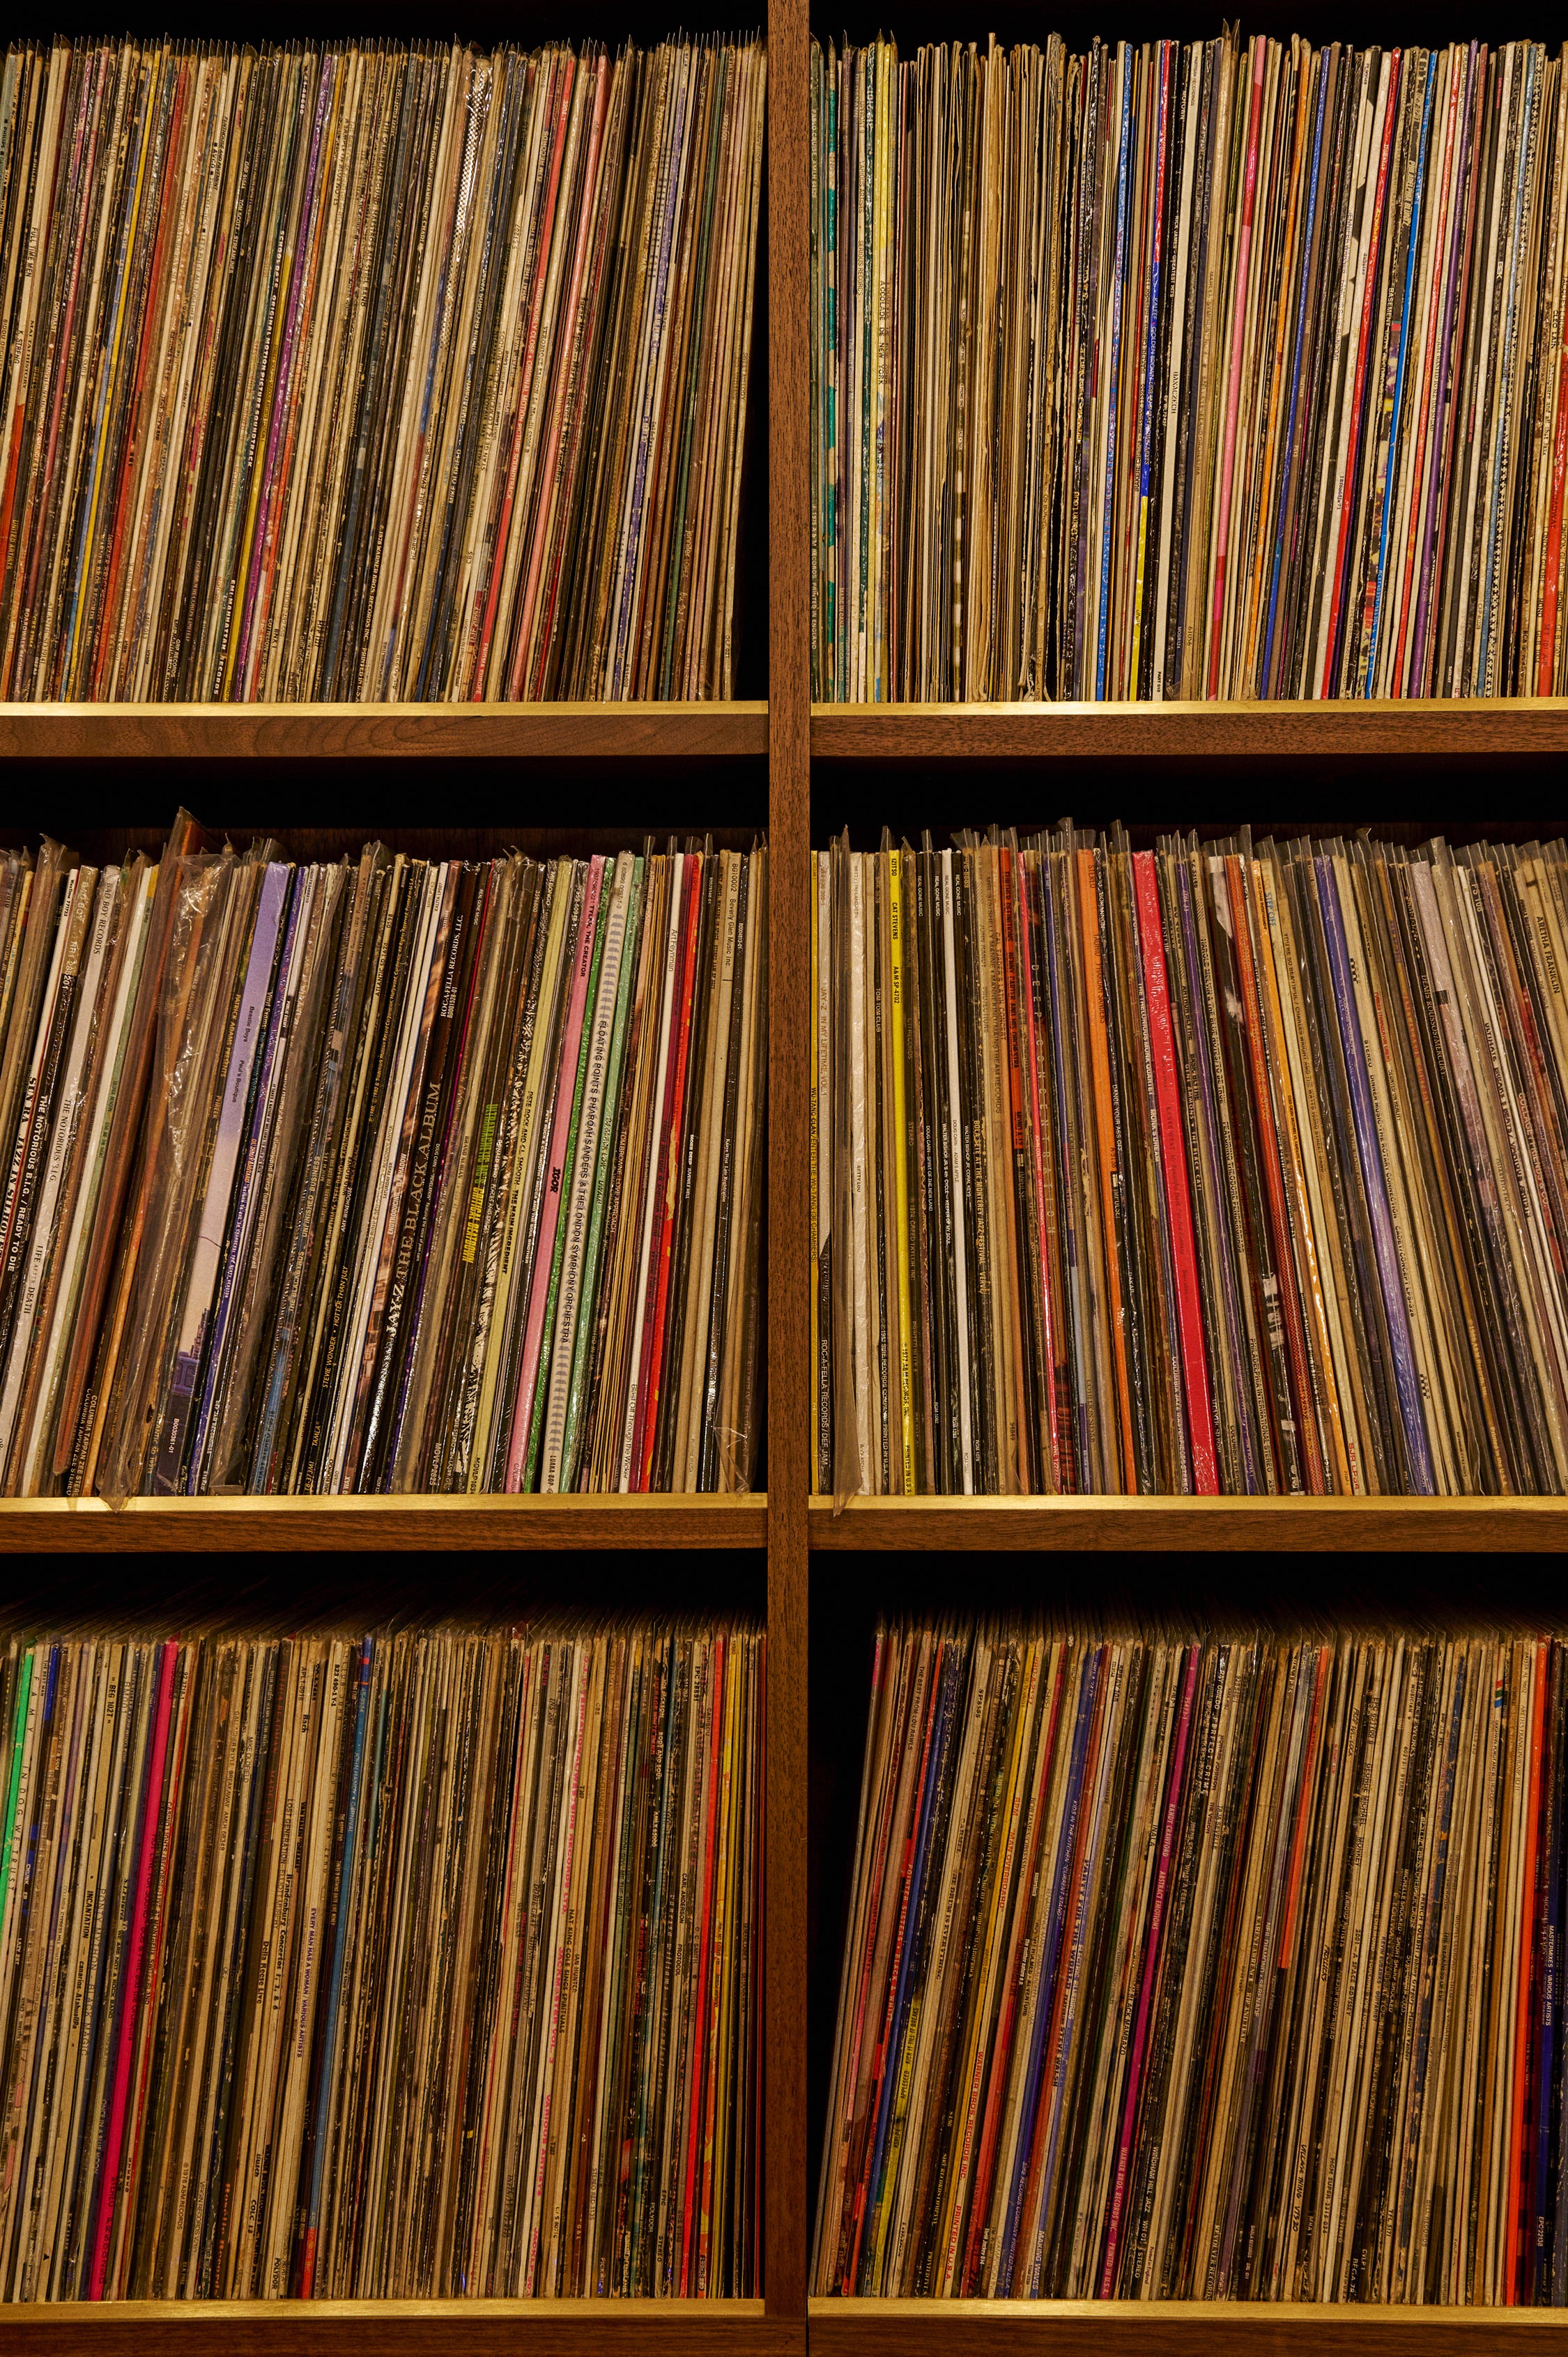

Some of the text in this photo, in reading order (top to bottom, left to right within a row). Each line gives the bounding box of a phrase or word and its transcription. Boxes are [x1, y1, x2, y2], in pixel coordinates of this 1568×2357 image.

[29, 227, 38, 243] FULL
[27, 245, 36, 261] TIME
[229, 236, 239, 273] STREAMLINES
[507, 361, 532, 500] ORIGINAL MOTION PICTURE SOUNDTRACK
[729, 863, 738, 891] BG10002
[93, 883, 113, 954] BAD BOY RECORDS
[728, 898, 736, 920] Beverly
[581, 946, 590, 977] CREATOR
[667, 929, 678, 972] Art Feynman
[725, 938, 734, 954] Music
[725, 955, 733, 968] Inc.
[1537, 916, 1560, 994] ARETHA FRANKLIN
[1421, 976, 1433, 999] DEMIS
[243, 1006, 255, 1042] Beastie Boys
[1098, 995, 1106, 1023] SANDERS
[220, 995, 240, 1077] PATRICK ADAMS PRESENTS
[594, 1020, 606, 1061] FLOATING
[821, 1025, 827, 1037] MY
[25, 1077, 37, 1100] SUN
[231, 1060, 245, 1103] Paul's Boutique
[590, 1063, 601, 1093] POINTS
[21, 1103, 32, 1123] RA
[36, 1095, 48, 1112] THE
[212, 1096, 222, 1119] PHREEK
[585, 1098, 598, 1138] PHAROAH
[10, 1137, 24, 1167] JAZZ
[26, 1115, 43, 1169] NOTORIOUS
[578, 1138, 590, 1178] SANDERS
[616, 1146, 625, 1175] BROWNE
[6, 1170, 18, 1185] IN
[20, 1172, 33, 1197] B.I.G.
[550, 1167, 560, 1192] IGOR
[342, 1187, 351, 1220] WINEHOUSE
[387, 1082, 440, 1337] JAY-Z THE BLACK ALBUM
[576, 1190, 585, 1206] THE
[13, 1207, 26, 1238] READY
[571, 1208, 583, 1242] LONDON
[610, 1197, 620, 1232] APPROACH
[10, 1241, 21, 1252] TO
[32, 1246, 43, 1263] LIFE
[7, 1254, 18, 1272] DIE
[567, 1245, 580, 1291] SYMPHONY
[24, 1287, 36, 1314] DEATH
[322, 1266, 348, 1388] STEVIE WONDER HOTTER THAN JULY
[562, 1293, 575, 1343] ORCHESTRA
[169, 1418, 179, 1454] B0030361-01
[548, 1455, 556, 1473] LUAKA
[1263, 1445, 1272, 1472] STEREO
[107, 1685, 116, 1699] BEG
[1151, 1804, 1175, 1930] RANDY CRAWFORD ABSTRACT EMOTIONS
[82, 1891, 93, 1938] INCANTATION
[972, 2051, 983, 2089] WARNER
[962, 2119, 974, 2161] RECORDS
[945, 2206, 961, 2282] PRINTED IN U.S.A.
[1032, 2231, 1044, 2289] MAKING WAVES
